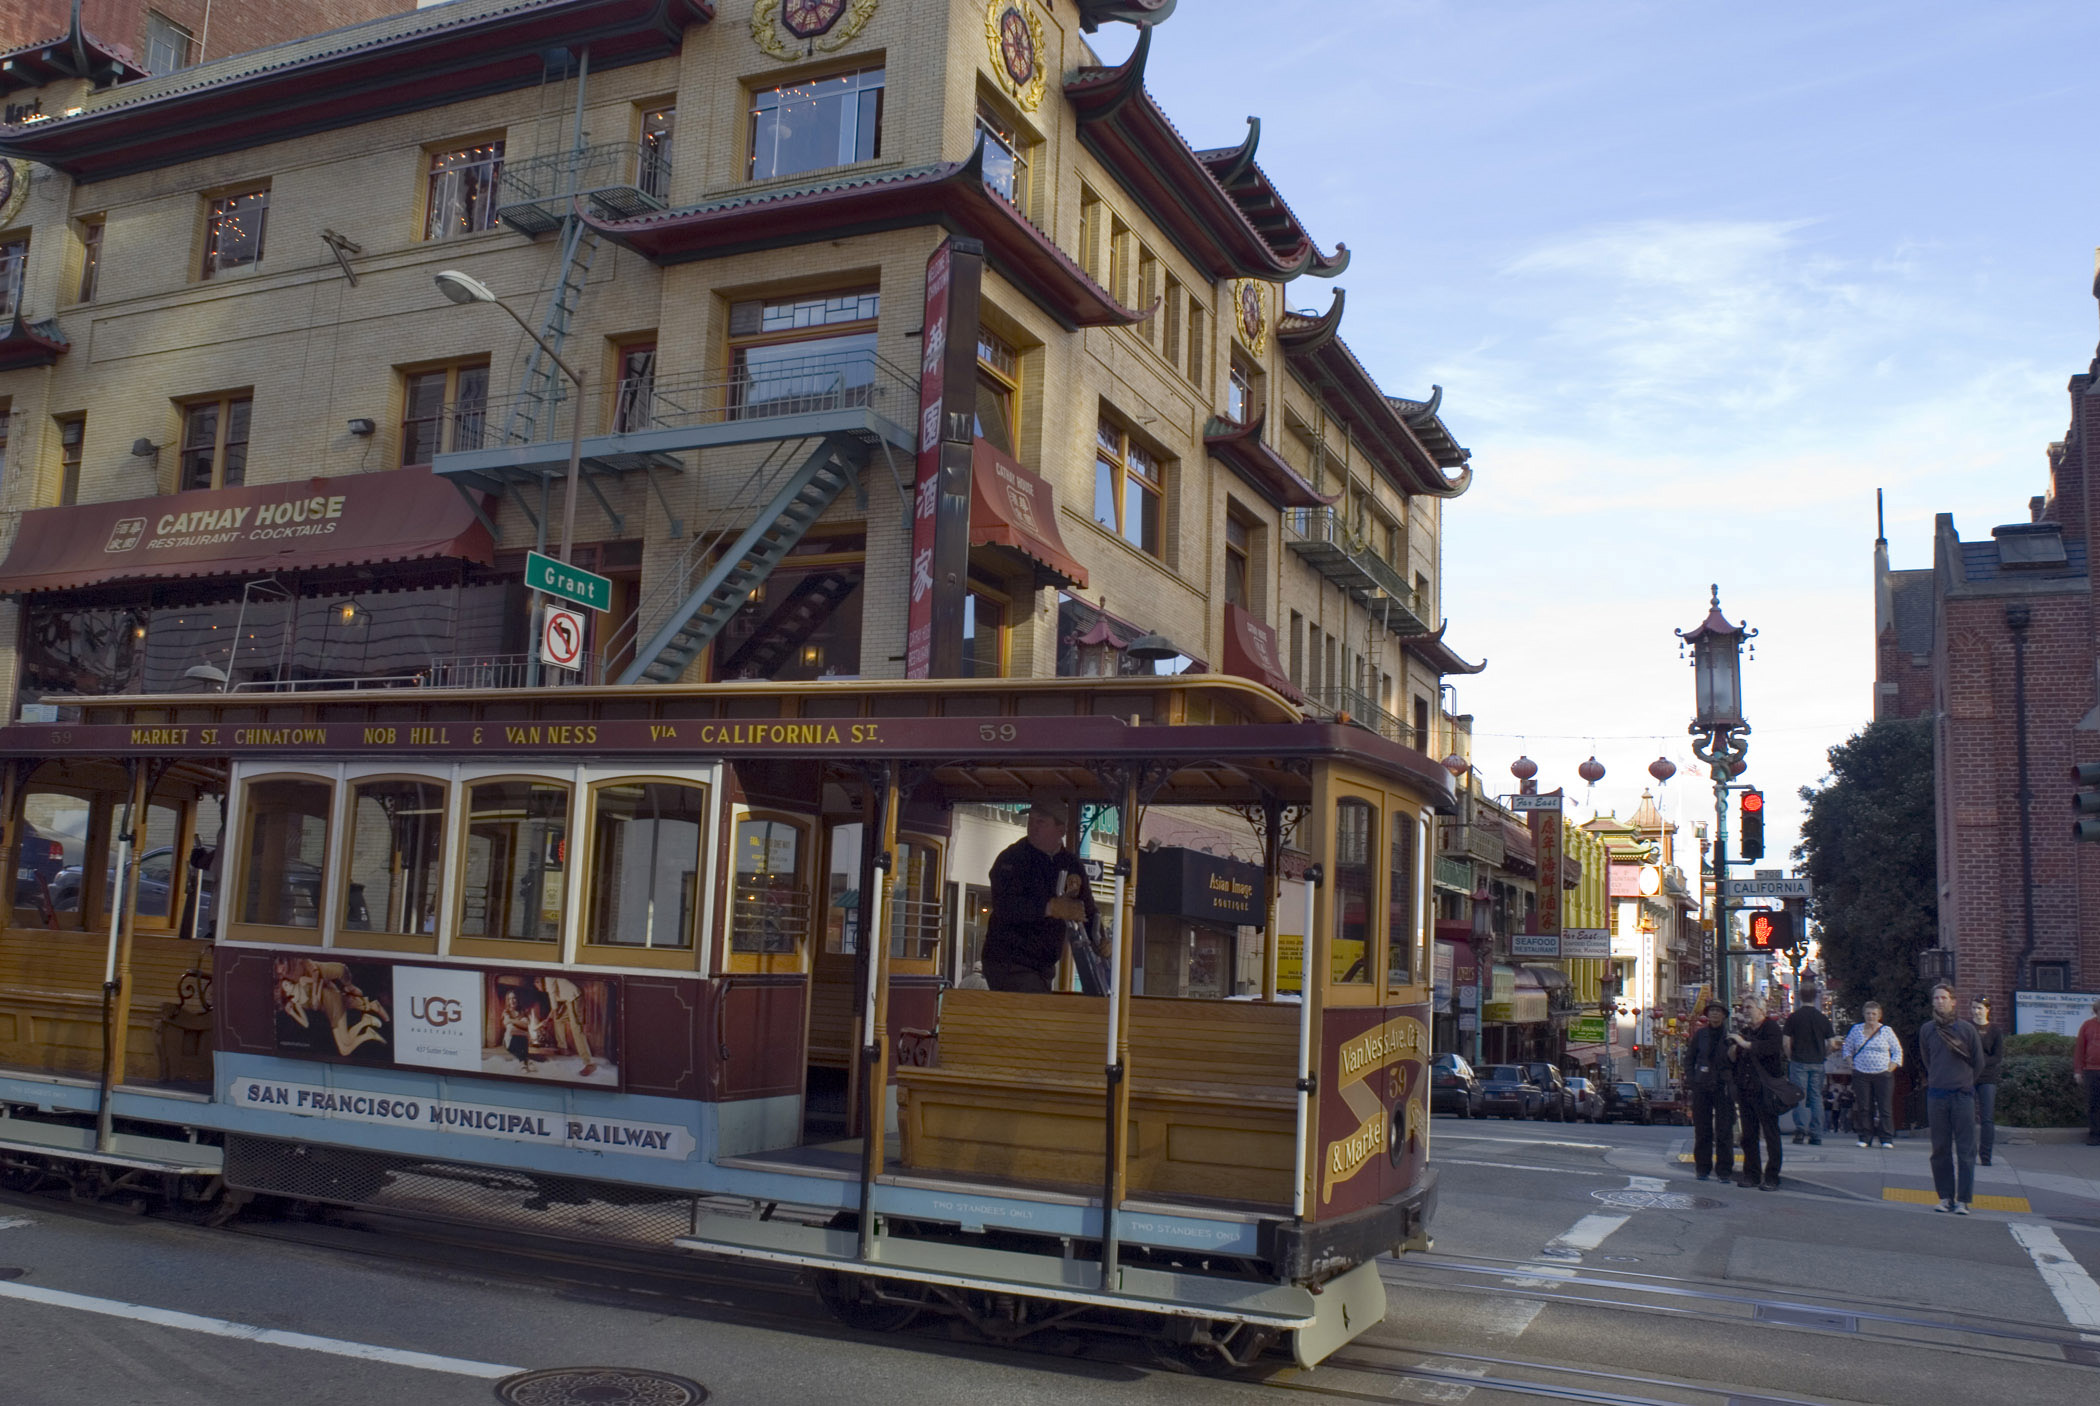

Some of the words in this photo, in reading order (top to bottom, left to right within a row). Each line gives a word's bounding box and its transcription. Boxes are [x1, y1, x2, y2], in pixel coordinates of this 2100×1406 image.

[995, 462, 1016, 487] CATHAY
[1016, 476, 1034, 497] HOUSE
[156, 506, 252, 535] CATHAY
[254, 496, 346, 527] HOUSE
[146, 532, 241, 551] RESTAURANT
[249, 522, 337, 541] COCKTAILS
[544, 567, 595, 599] Grant
[50, 731, 72, 745] 59
[131, 729, 189, 745] MARKET
[201, 730, 221, 745] ST.
[235, 728, 327, 745] CHINATOWN
[364, 727, 396, 744] NOB
[410, 727, 450, 744] HILL
[473, 727, 483, 744] &
[505, 727, 541, 744] VAN
[547, 726, 598, 744] NESS
[701, 724, 841, 744] CALIFORNIA
[851, 724, 885, 744] ST.
[978, 724, 1017, 742] 59
[1516, 797, 1532, 807] Far
[1535, 797, 1557, 807] East
[1209, 872, 1230, 892] Asian
[1232, 877, 1253, 899] Image
[1733, 882, 1805, 894] CALIFORNIA
[1213, 898, 1249, 911] BOUTIQUE
[1515, 938, 1557, 946] SEAFOOD
[1577, 930, 1597, 941] East
[1704, 931, 1713, 959] FOUR
[2060, 995, 2088, 1003] Mary's
[411, 996, 462, 1028] UGG
[411, 1027, 463, 1036] australia
[442, 1048, 458, 1056] Street
[1342, 1048, 1364, 1076] Van
[1363, 1032, 1389, 1063] Ness
[1390, 1026, 1407, 1051] Ave.
[1389, 1065, 1407, 1098] 59
[247, 1084, 289, 1105] SAN
[297, 1090, 420, 1121] FRANCISCO
[430, 1105, 551, 1136] MUNICIPAL
[567, 1121, 672, 1150] RAILWAY
[1332, 1145, 1343, 1173] &
[1345, 1121, 1386, 1169] Market
[932, 1200, 952, 1210] TWO
[956, 1203, 1006, 1217] STANDEES
[1010, 1209, 1034, 1219] ONLY
[1131, 1221, 1153, 1233] TWO
[1157, 1225, 1212, 1239] STANDEES
[1216, 1230, 1241, 1241] ONLY
